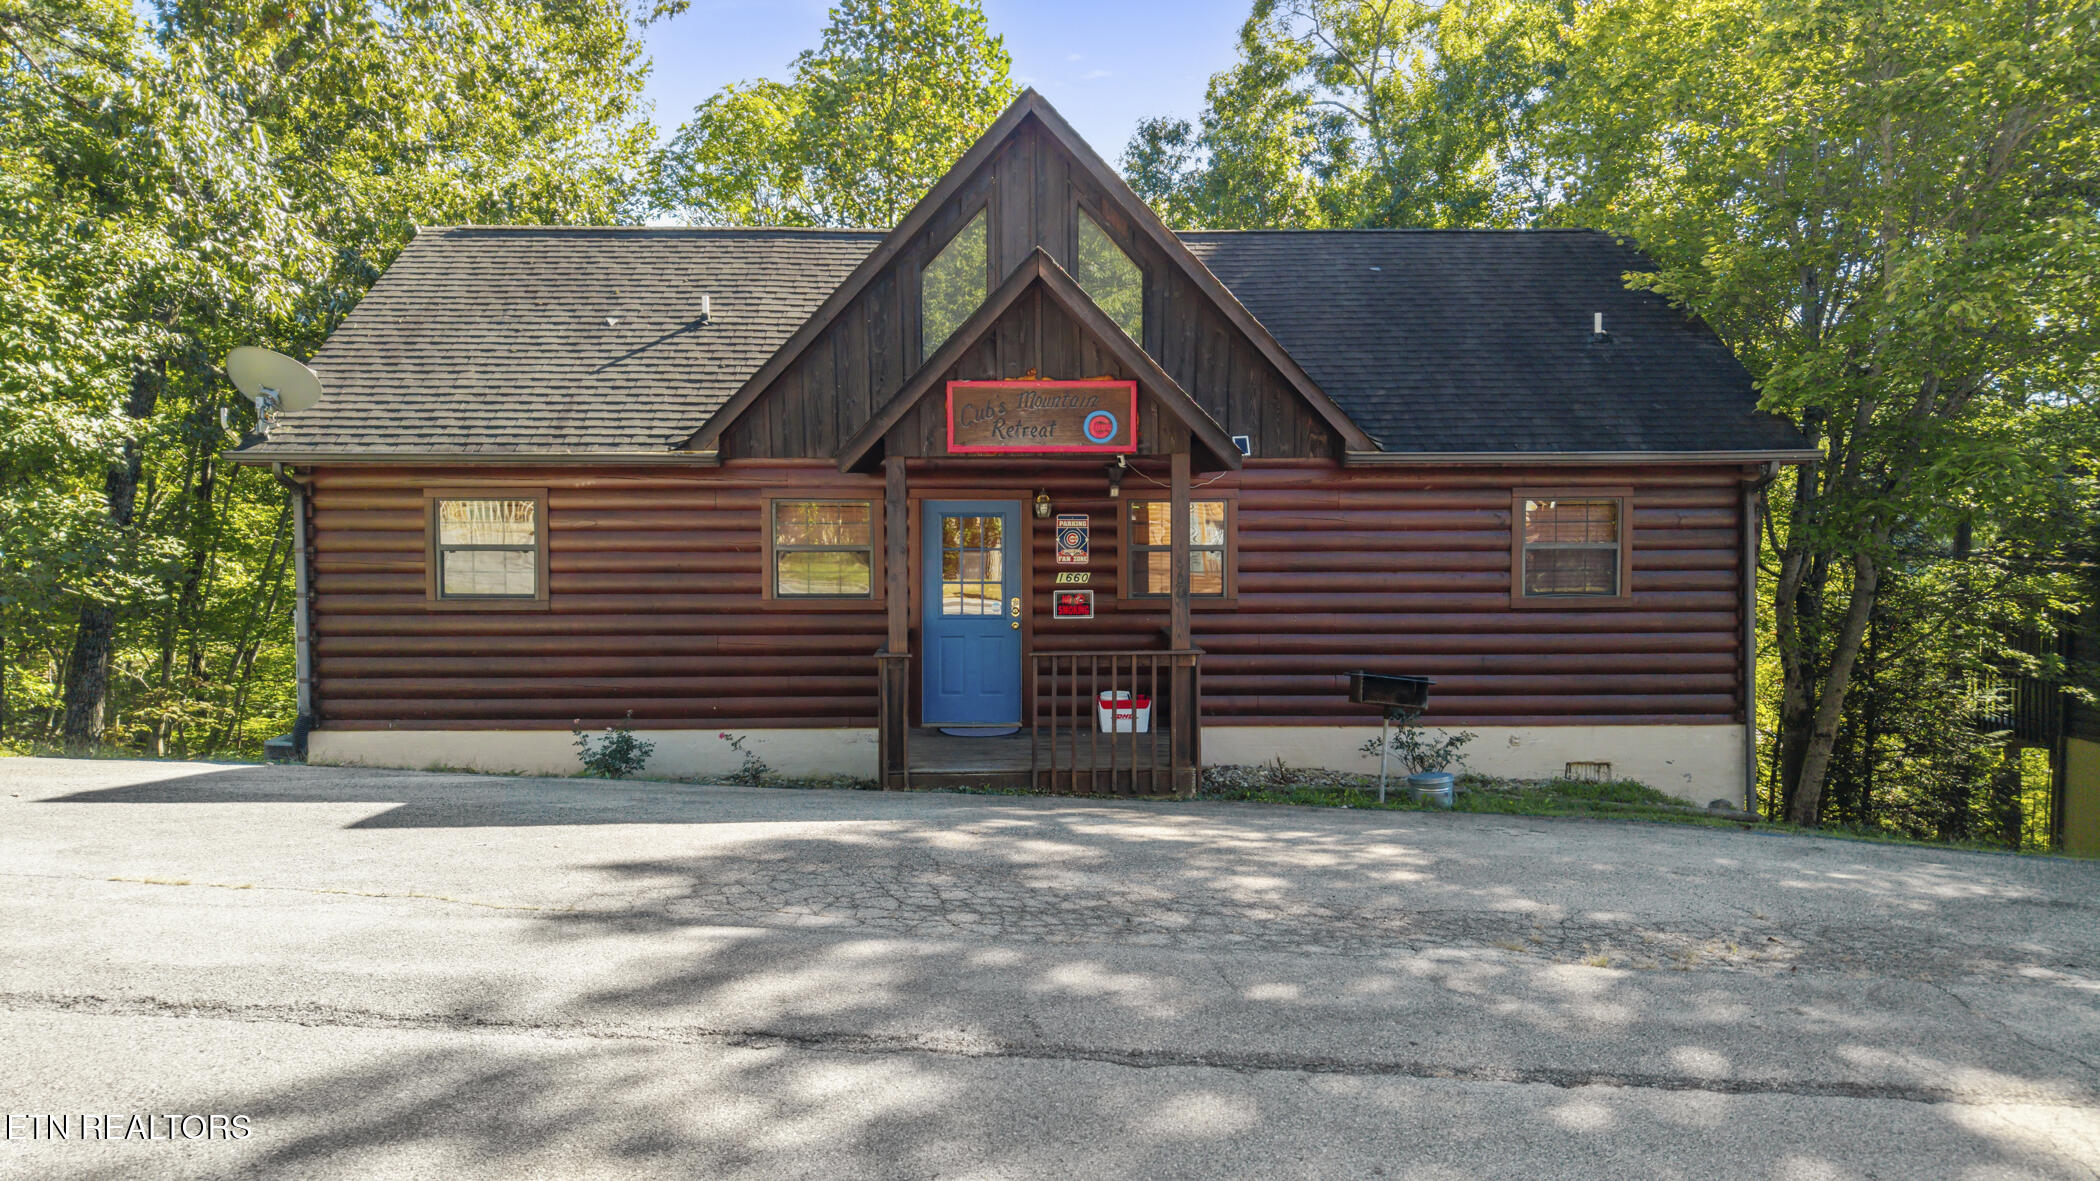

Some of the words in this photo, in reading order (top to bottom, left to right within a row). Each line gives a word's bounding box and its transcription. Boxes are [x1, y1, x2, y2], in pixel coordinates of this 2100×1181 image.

[960, 394, 1007, 429] Cub's
[1016, 391, 1099, 411] Mountain
[991, 417, 1057, 440] Retreat
[1059, 573, 1089, 583] 1660
[1061, 594, 1072, 604] NO
[1057, 605, 1090, 616] SMOKING
